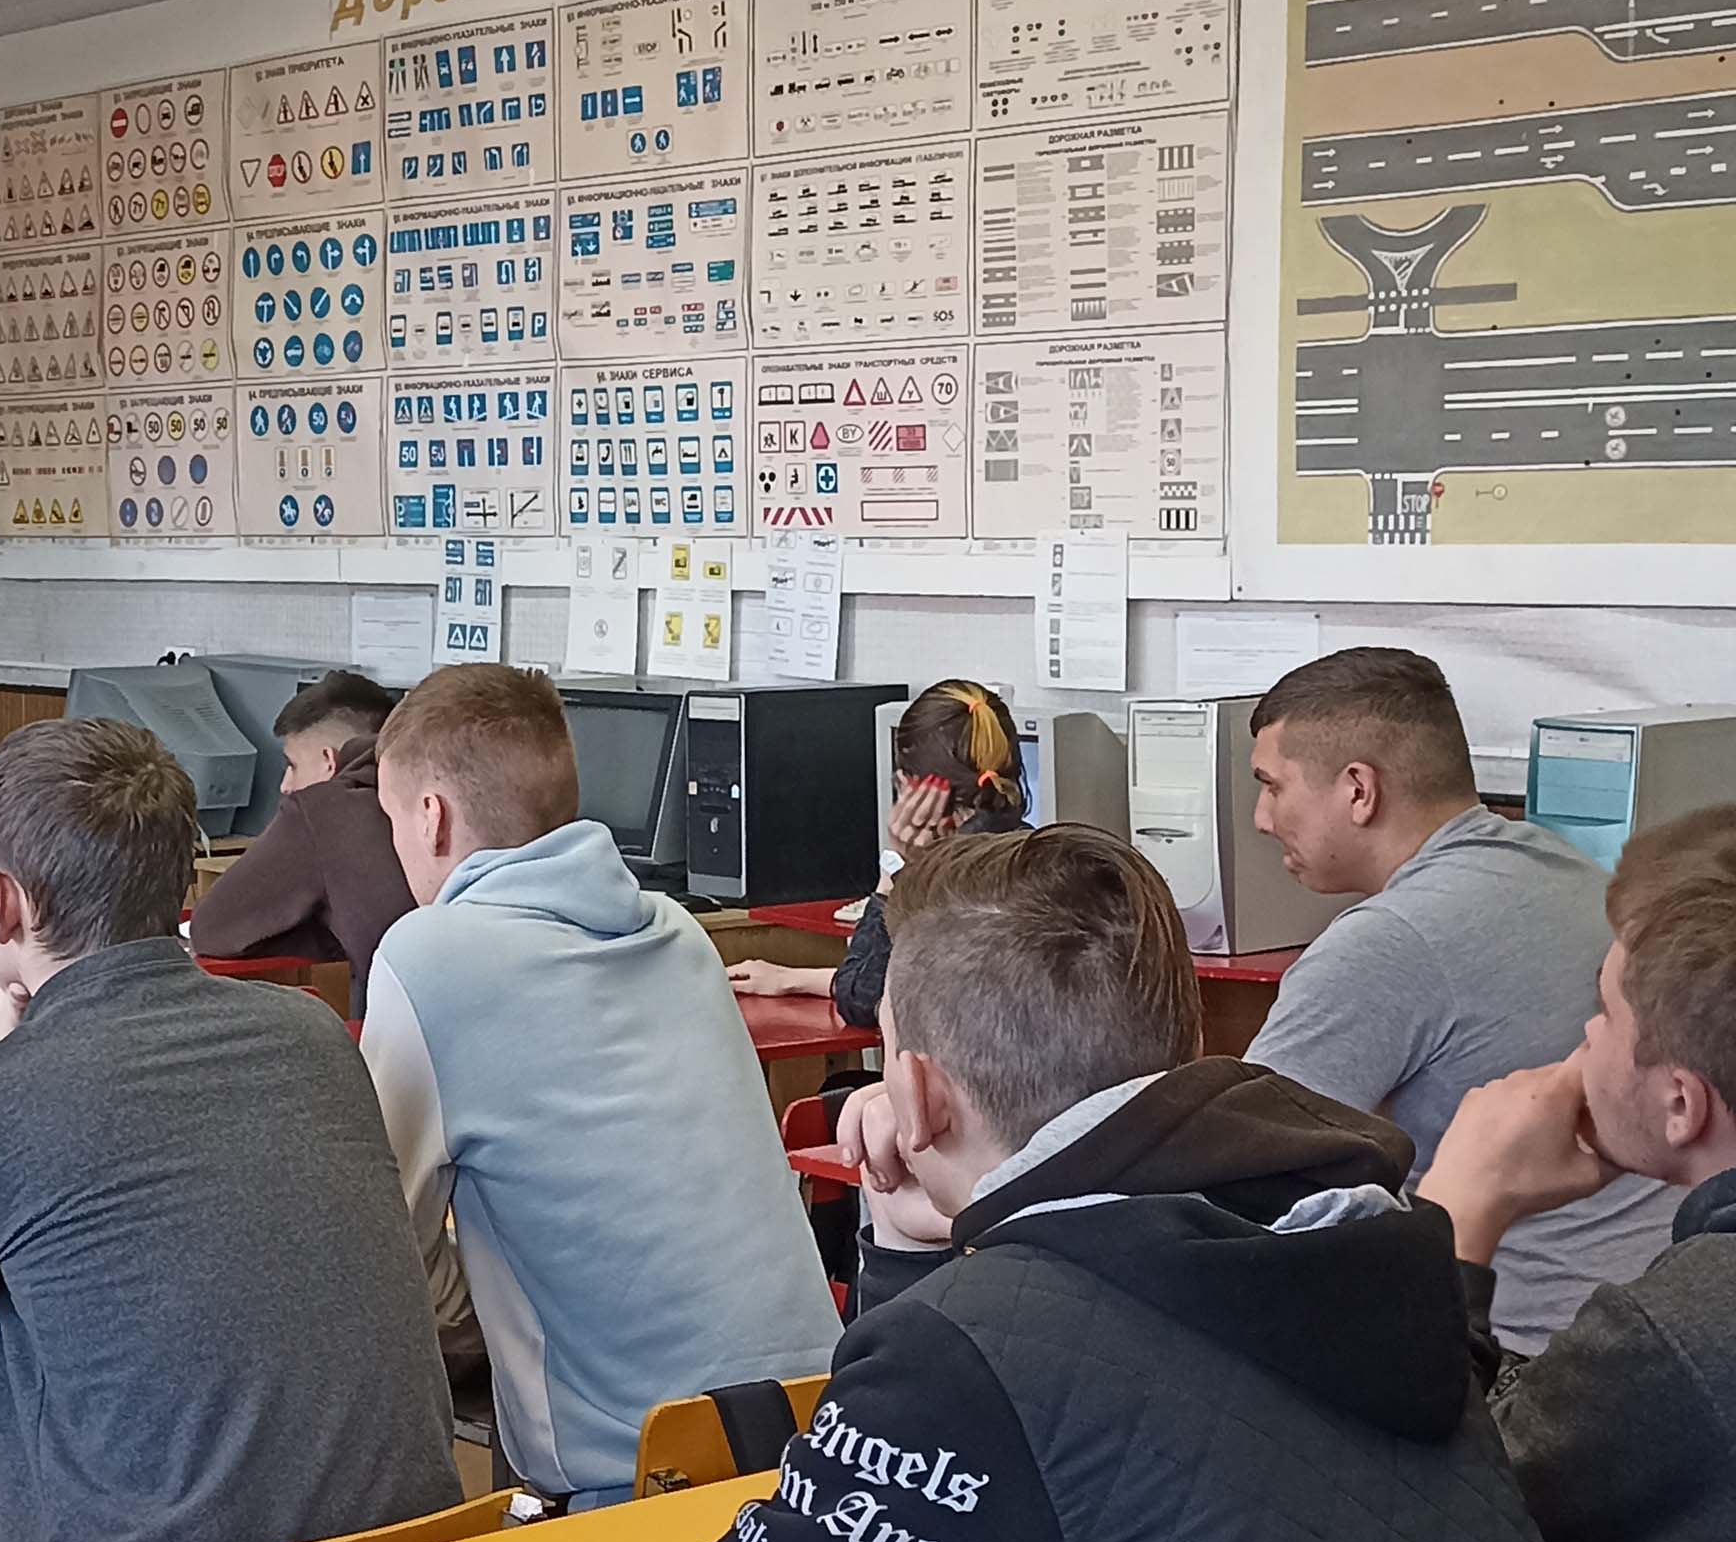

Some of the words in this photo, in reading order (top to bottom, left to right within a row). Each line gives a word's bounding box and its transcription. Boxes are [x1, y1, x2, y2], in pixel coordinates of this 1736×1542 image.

[933, 310, 954, 322] SOS
[610, 370, 638, 381] ЗНАКИ
[642, 367, 694, 379] СЕРВИСА
[937, 382, 953, 395] 70
[149, 418, 160, 433] 50
[170, 418, 182, 433] 50
[193, 417, 206, 432] 50
[216, 416, 227, 431] 50
[313, 413, 325, 425] 50
[842, 427, 857, 439] BY
[402, 446, 415, 462] 50
[1402, 494, 1430, 514] STOP
[803, 1401, 989, 1513] Angels
